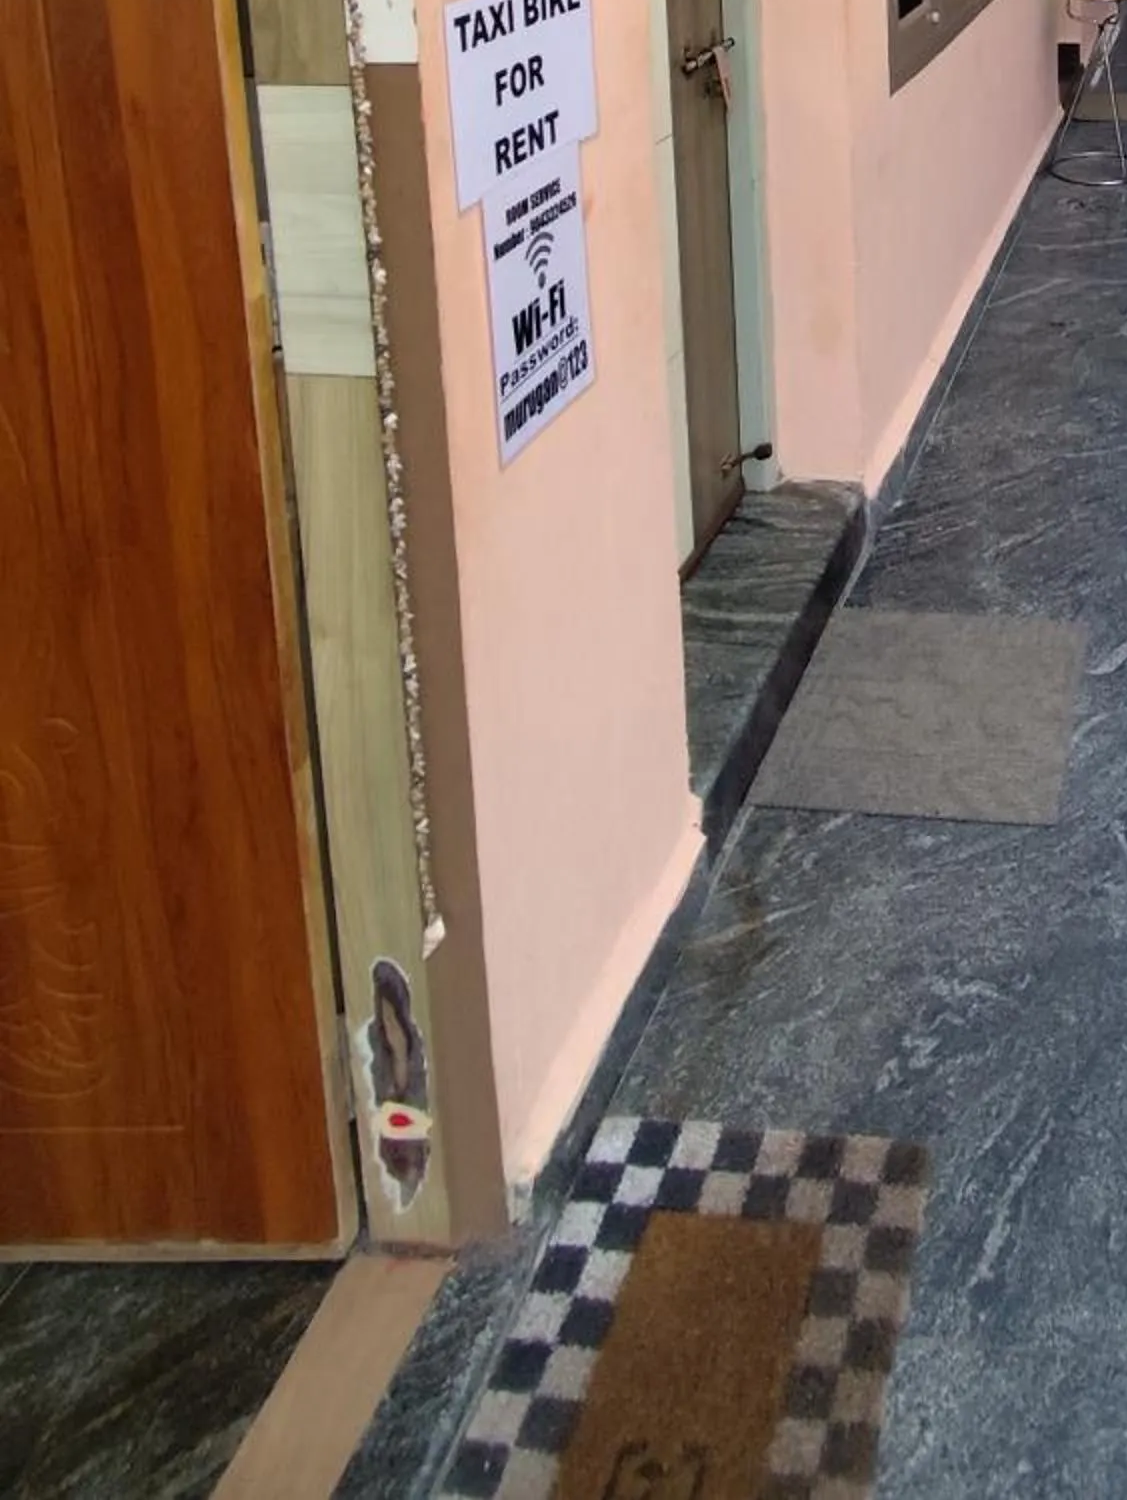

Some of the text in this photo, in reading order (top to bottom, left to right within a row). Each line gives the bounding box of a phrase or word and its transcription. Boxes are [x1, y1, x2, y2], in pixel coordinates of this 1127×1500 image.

[495, 55, 544, 107] FOR
[495, 110, 559, 176] RENT
[512, 279, 566, 356] Wi-Fi
[500, 315, 579, 397] Password:
